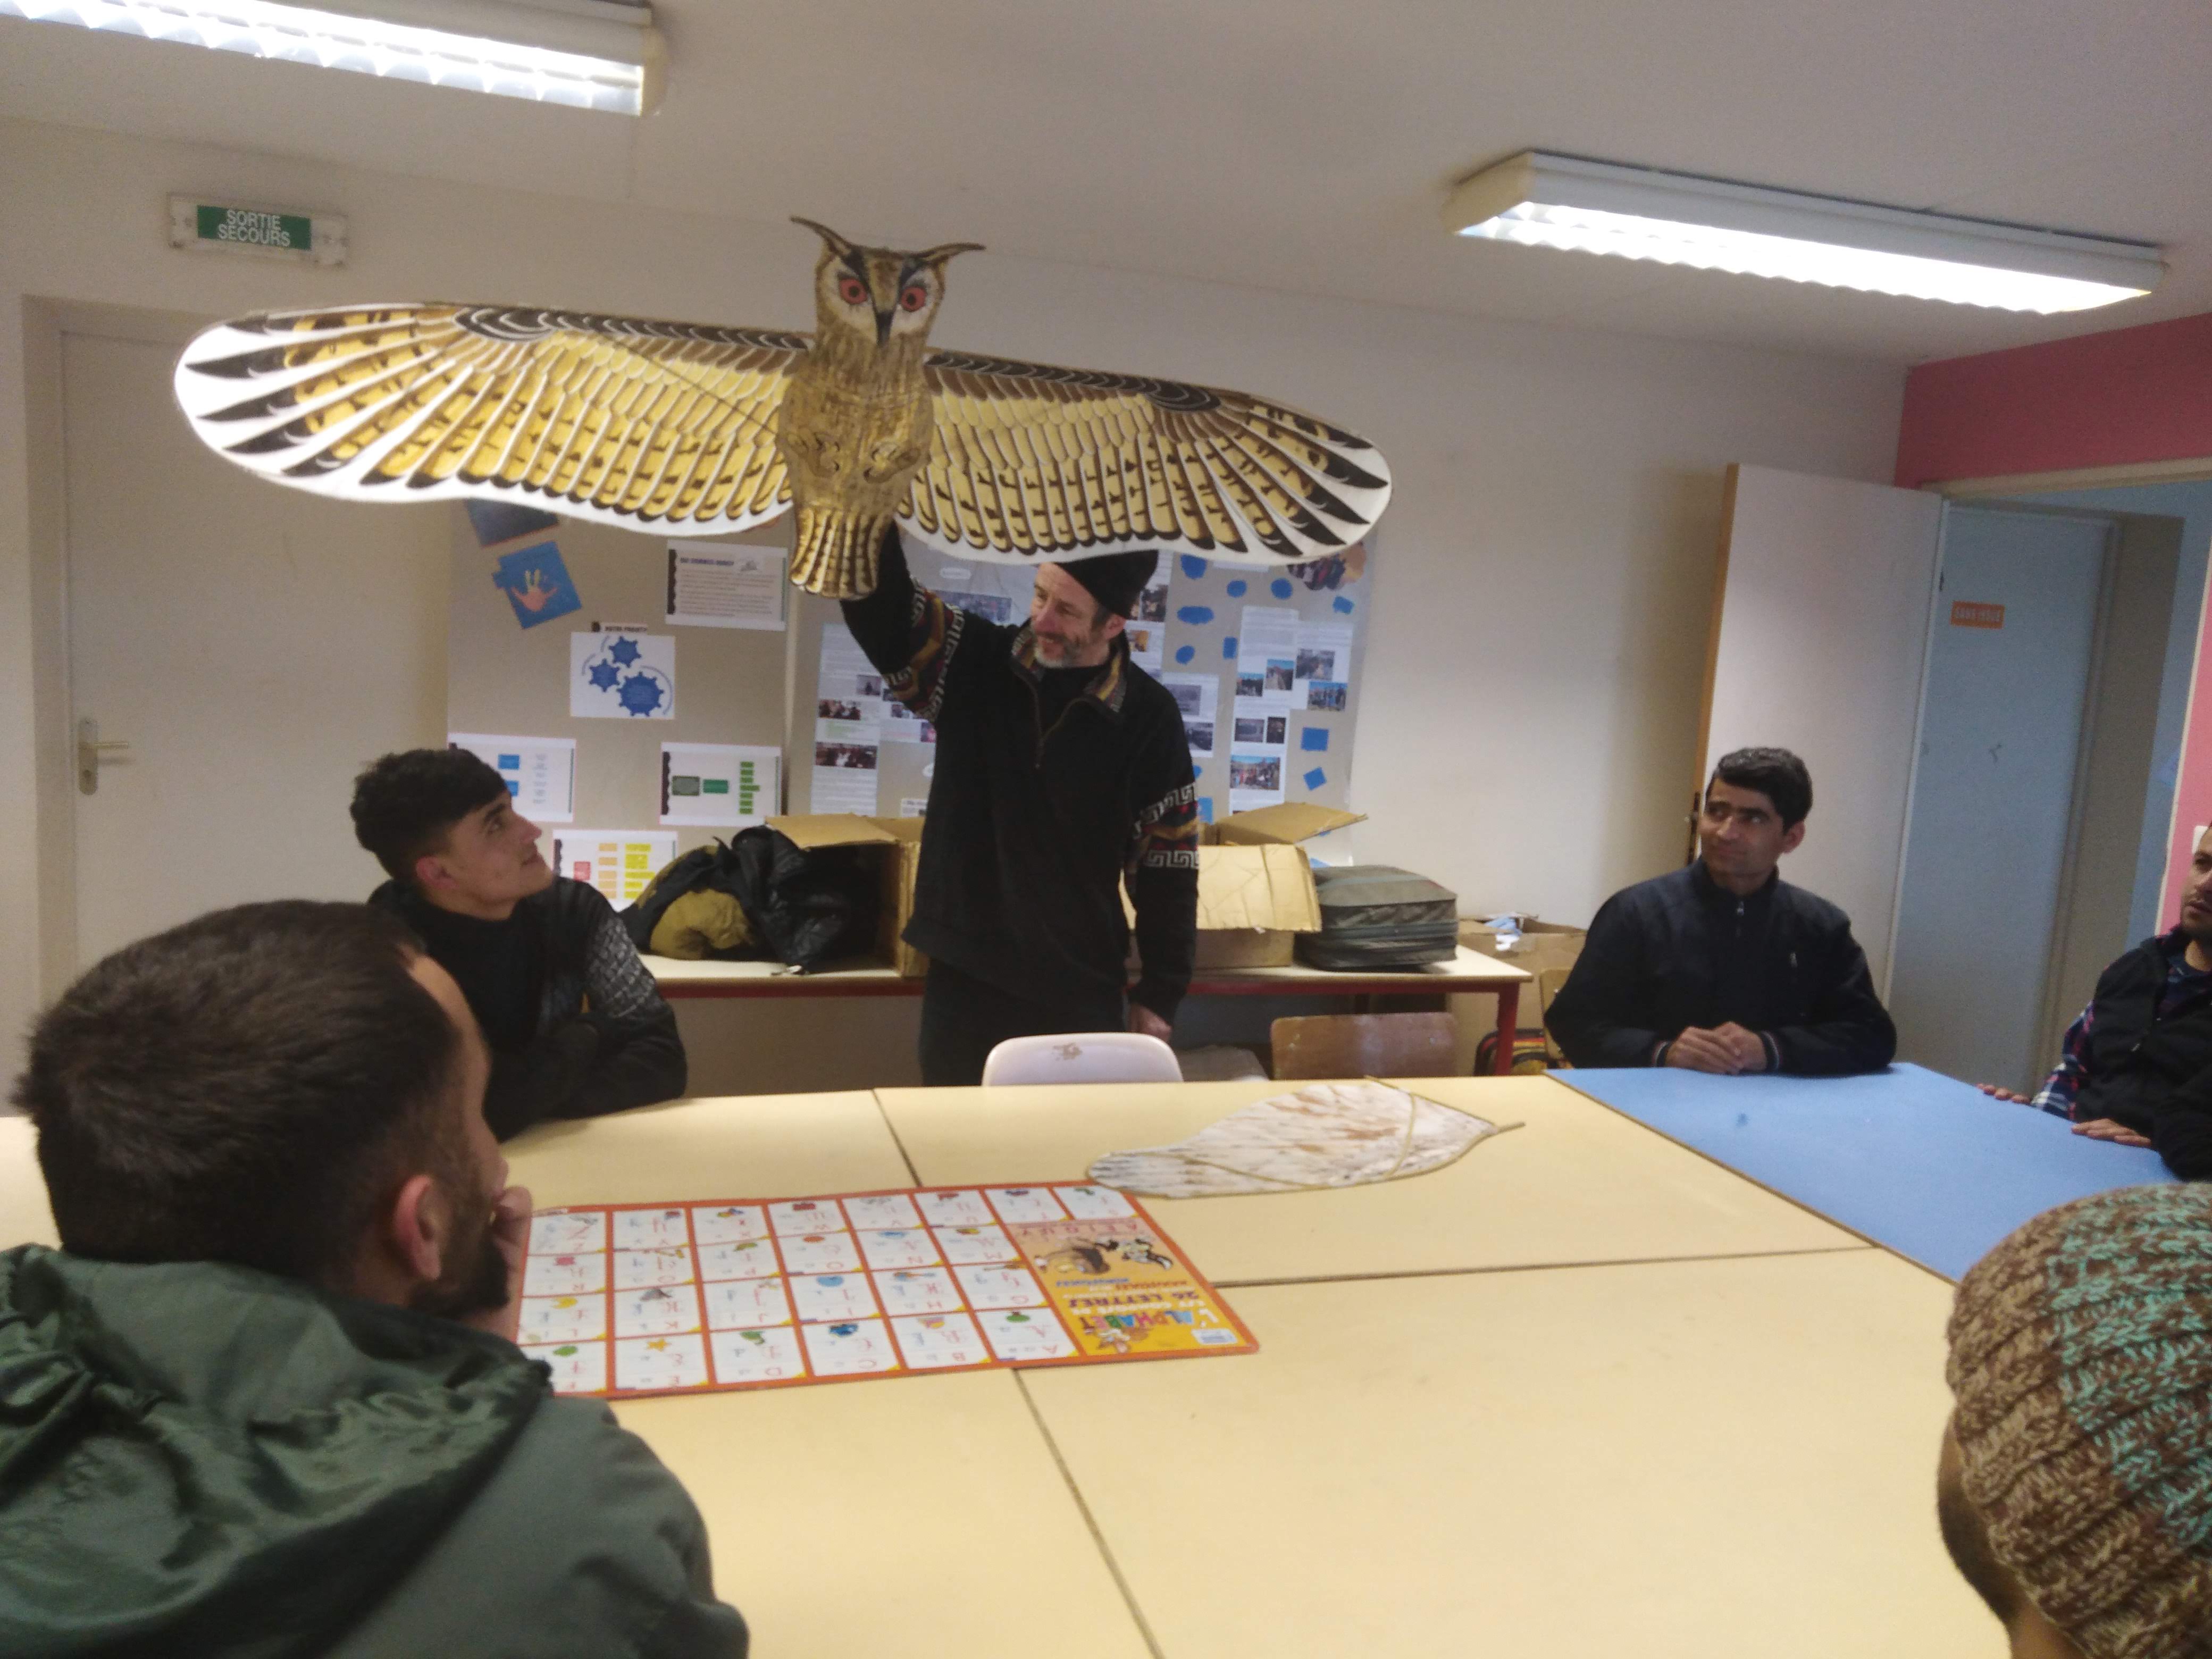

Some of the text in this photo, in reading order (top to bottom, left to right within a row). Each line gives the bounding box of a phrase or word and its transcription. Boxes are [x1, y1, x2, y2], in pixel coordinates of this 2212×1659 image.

[227, 208, 281, 231] SORTIE
[218, 224, 290, 246] SECOURS
[827, 1262, 843, 1270] O
[1069, 1293, 1163, 1308] LETTRES
[1042, 1345, 1058, 1354] A
[952, 1353, 966, 1361] B
[858, 1359, 877, 1369] C
[765, 1367, 782, 1376] D
[669, 1376, 681, 1386] E
